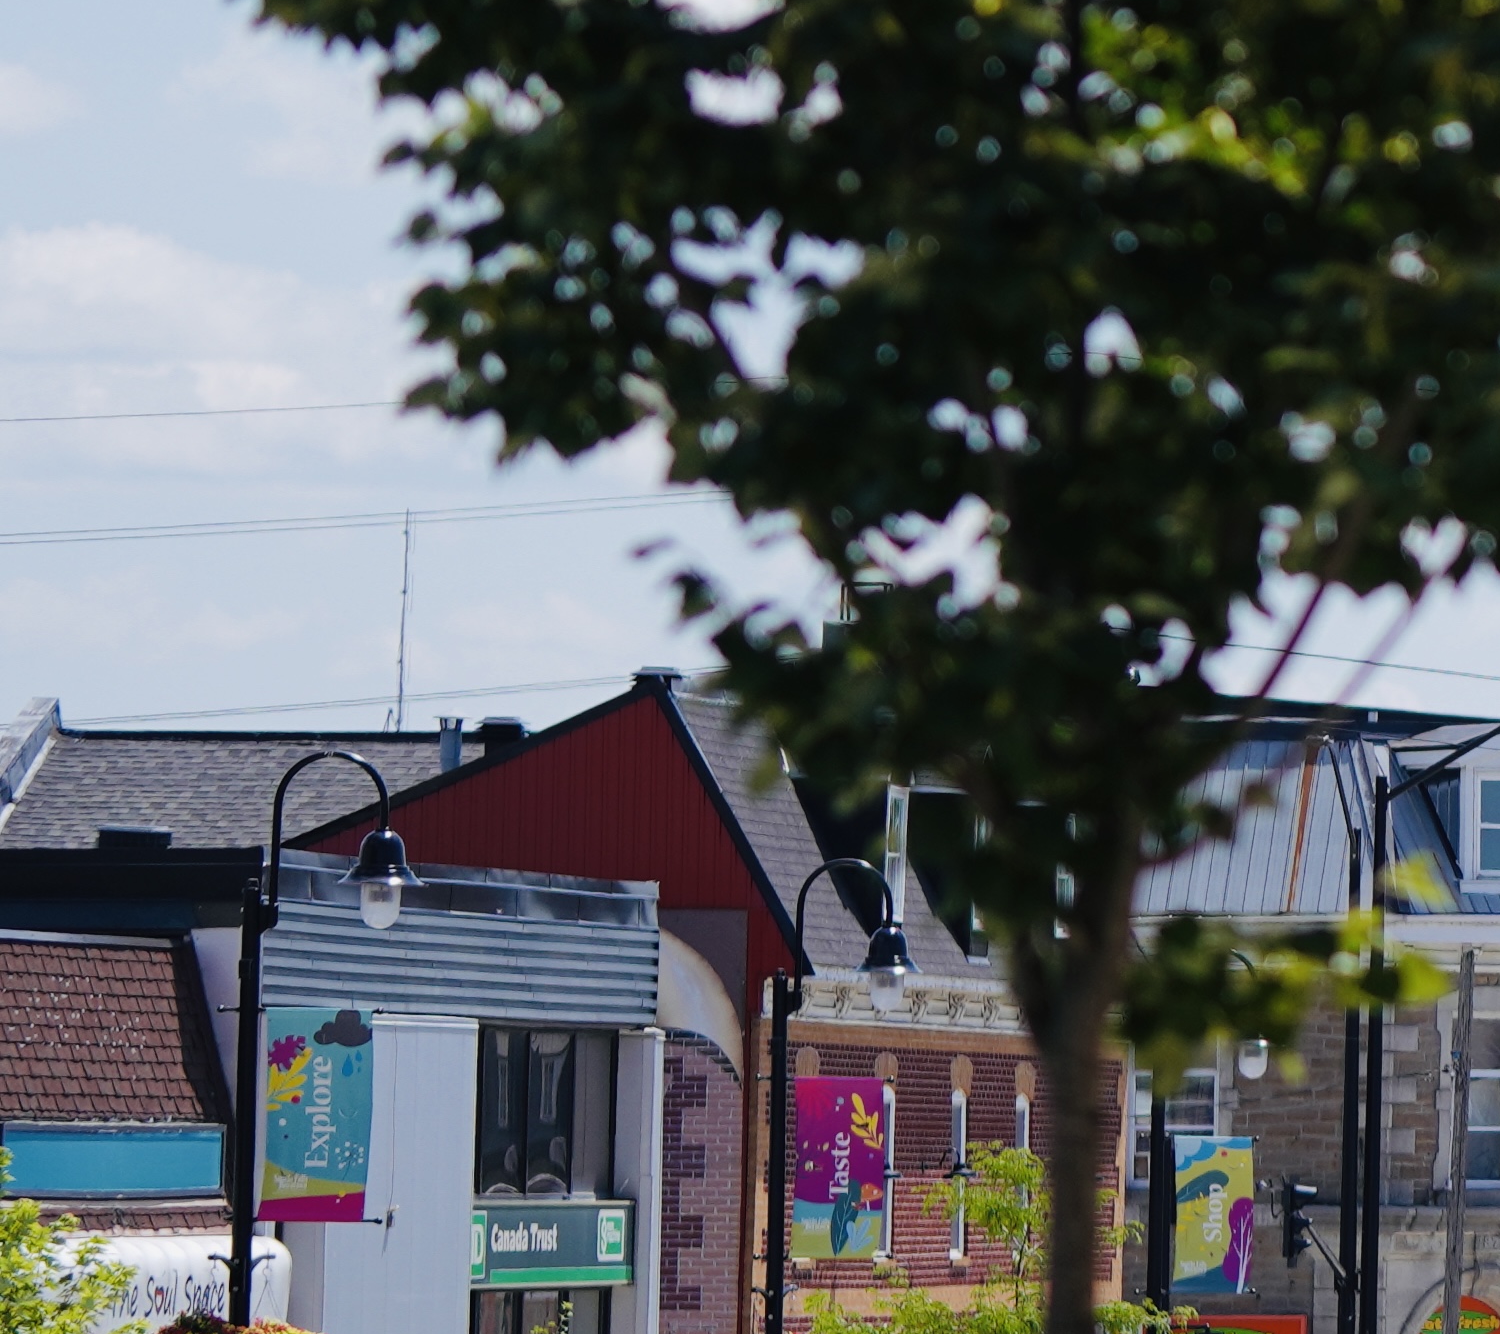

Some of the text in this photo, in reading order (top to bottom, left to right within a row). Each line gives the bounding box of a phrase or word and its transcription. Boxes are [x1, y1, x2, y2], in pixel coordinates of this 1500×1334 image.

[304, 1055, 336, 1169] Explore
[829, 1131, 851, 1200] Taste
[491, 1221, 529, 1252] Canada
[530, 1223, 558, 1251] Trust
[1203, 1183, 1228, 1243] Shop
[145, 1269, 178, 1317] Soul
